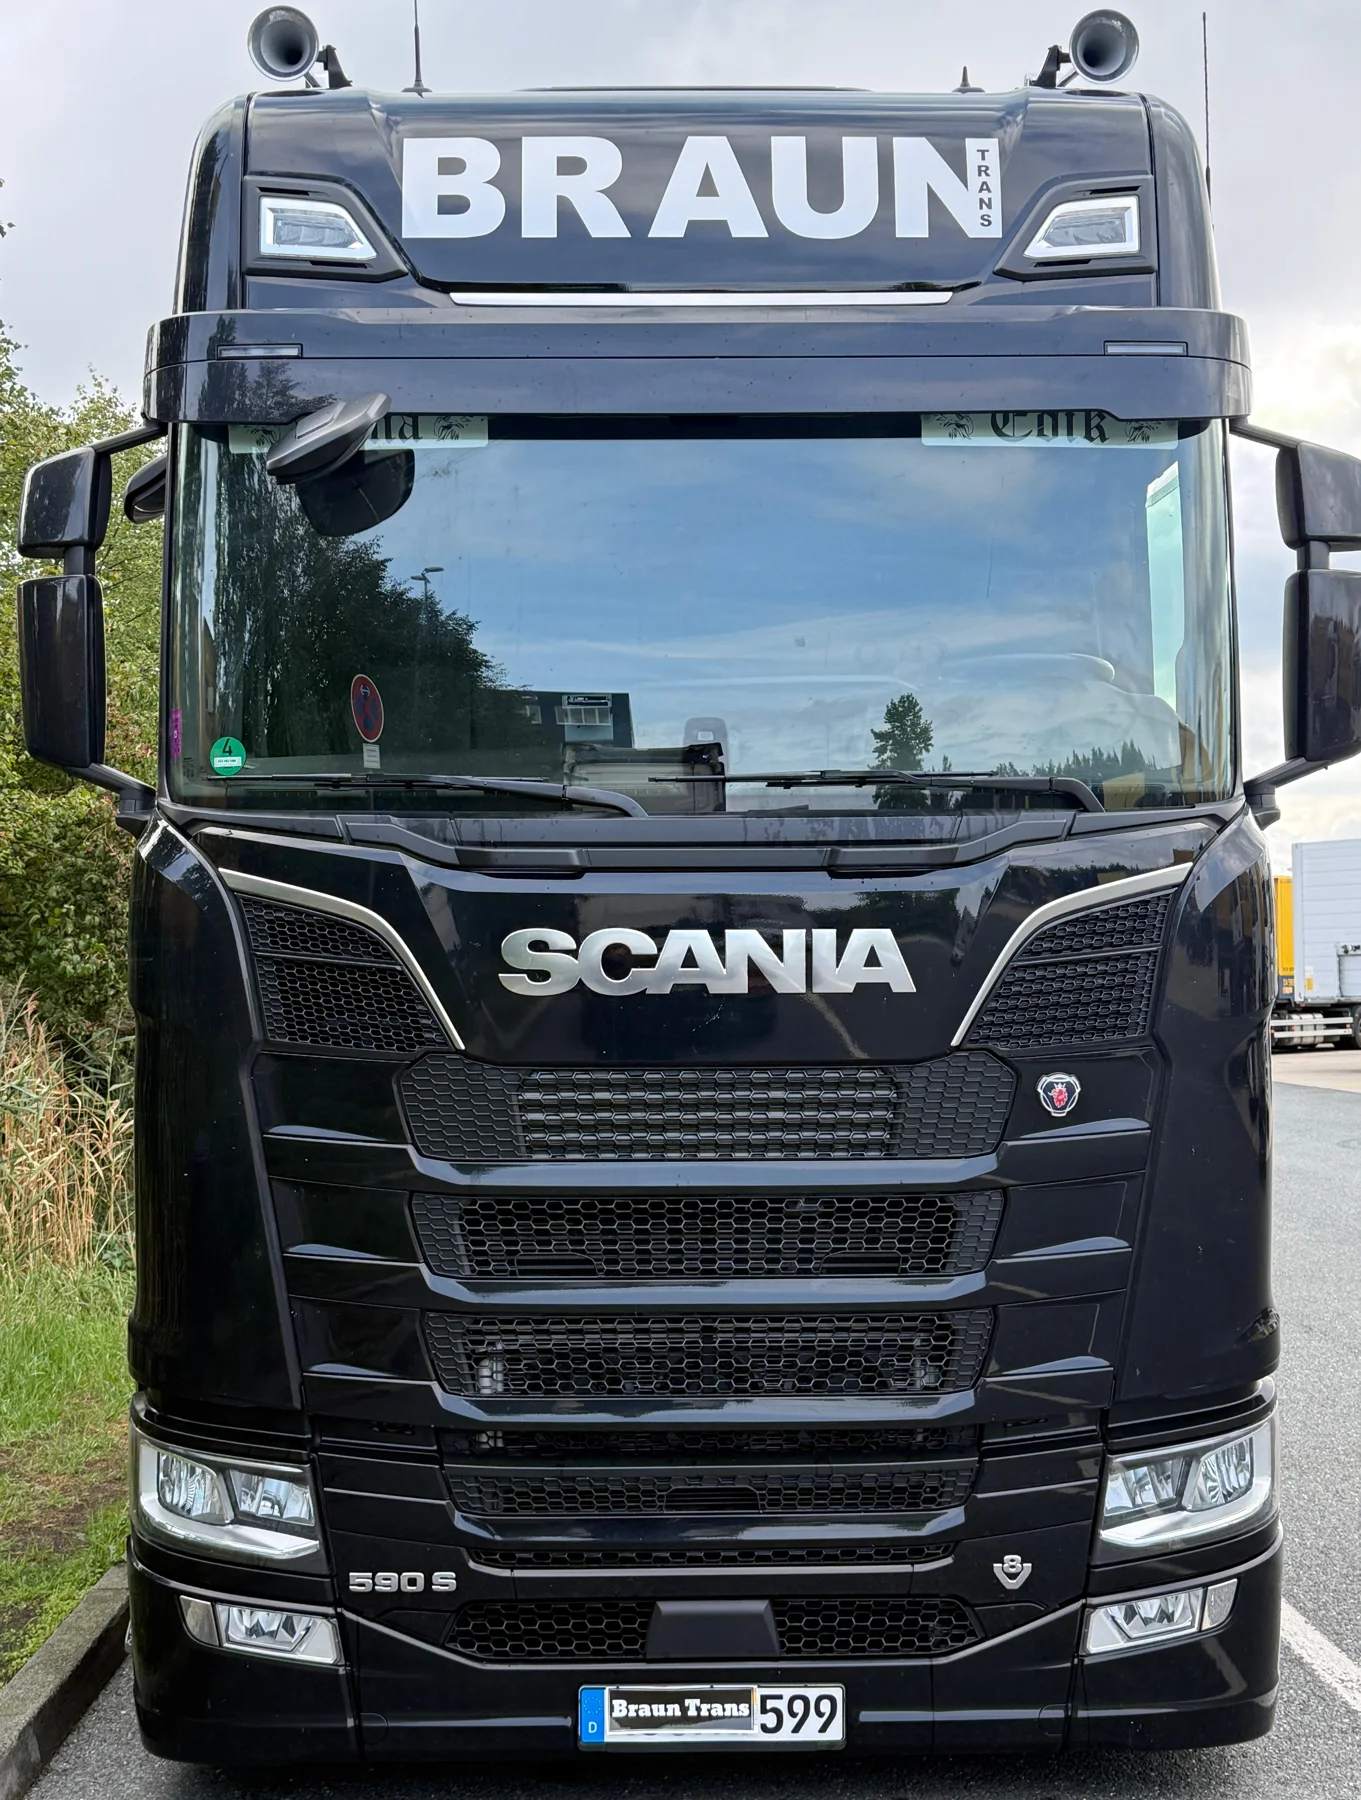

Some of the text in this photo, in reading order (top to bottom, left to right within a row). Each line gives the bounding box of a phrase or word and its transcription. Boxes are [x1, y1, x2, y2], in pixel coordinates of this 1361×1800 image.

[401, 136, 1003, 239] BRAUN
[976, 149, 993, 227] TRANS
[222, 738, 233, 756] 4
[498, 927, 917, 996] SCANIA
[349, 1572, 457, 1592] 590 S
[611, 1699, 750, 1718] Braun Trans
[760, 1694, 838, 1734] 599
[588, 1722, 597, 1733] D
